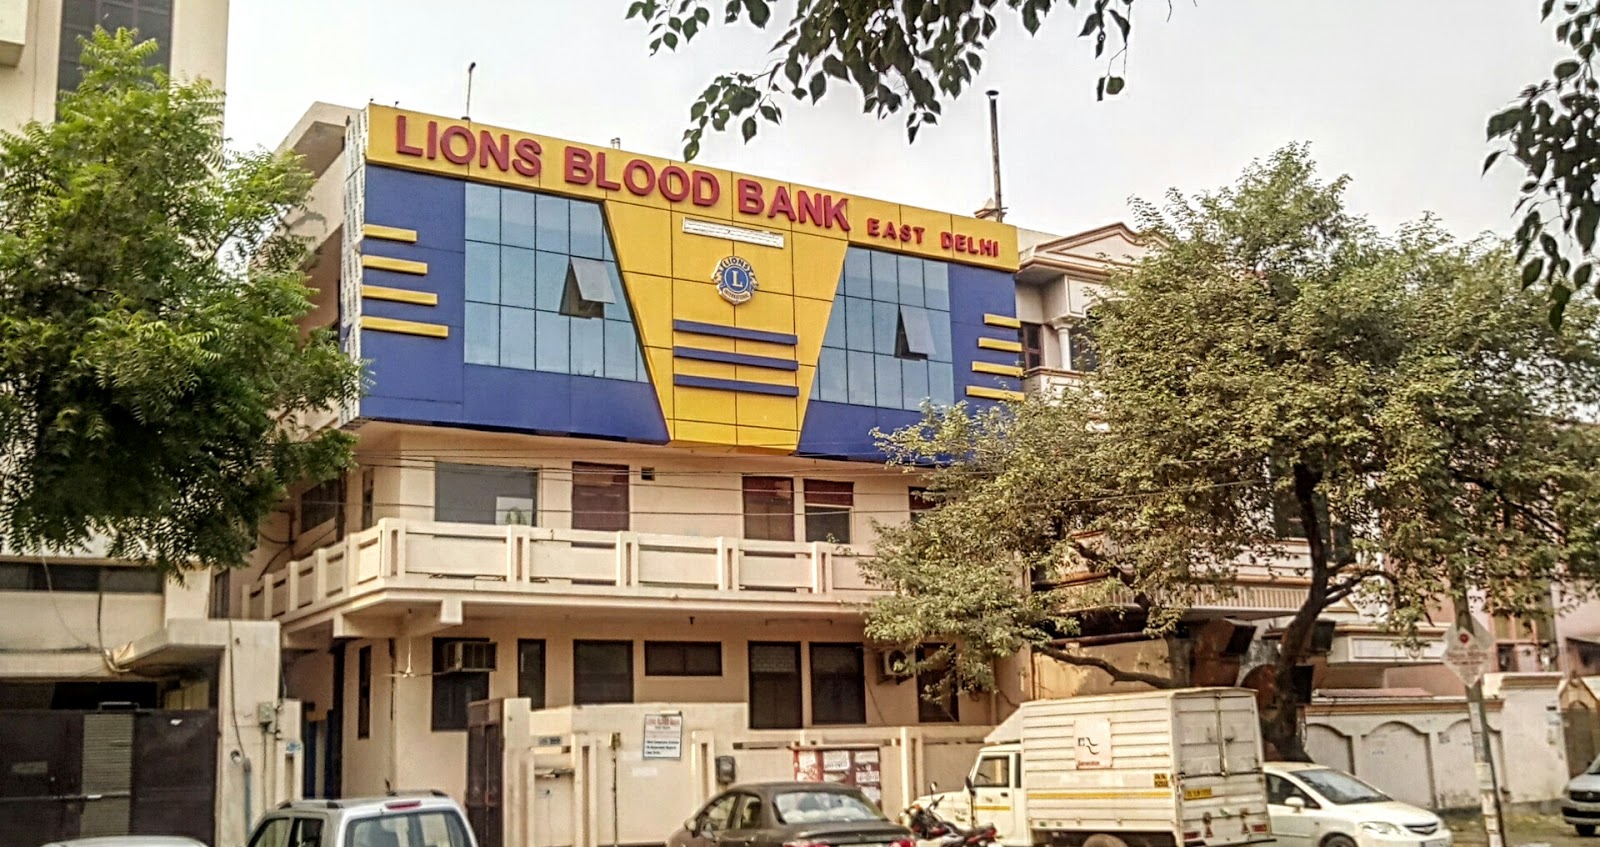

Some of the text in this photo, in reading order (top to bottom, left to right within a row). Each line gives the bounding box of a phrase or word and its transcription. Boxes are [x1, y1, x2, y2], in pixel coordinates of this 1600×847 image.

[396, 115, 543, 178] LIONS
[565, 146, 721, 207] BLOOD
[738, 178, 851, 232] BANK
[867, 217, 1000, 257] EAST DELHI
[723, 258, 748, 269] LIONS
[732, 270, 743, 287] L
